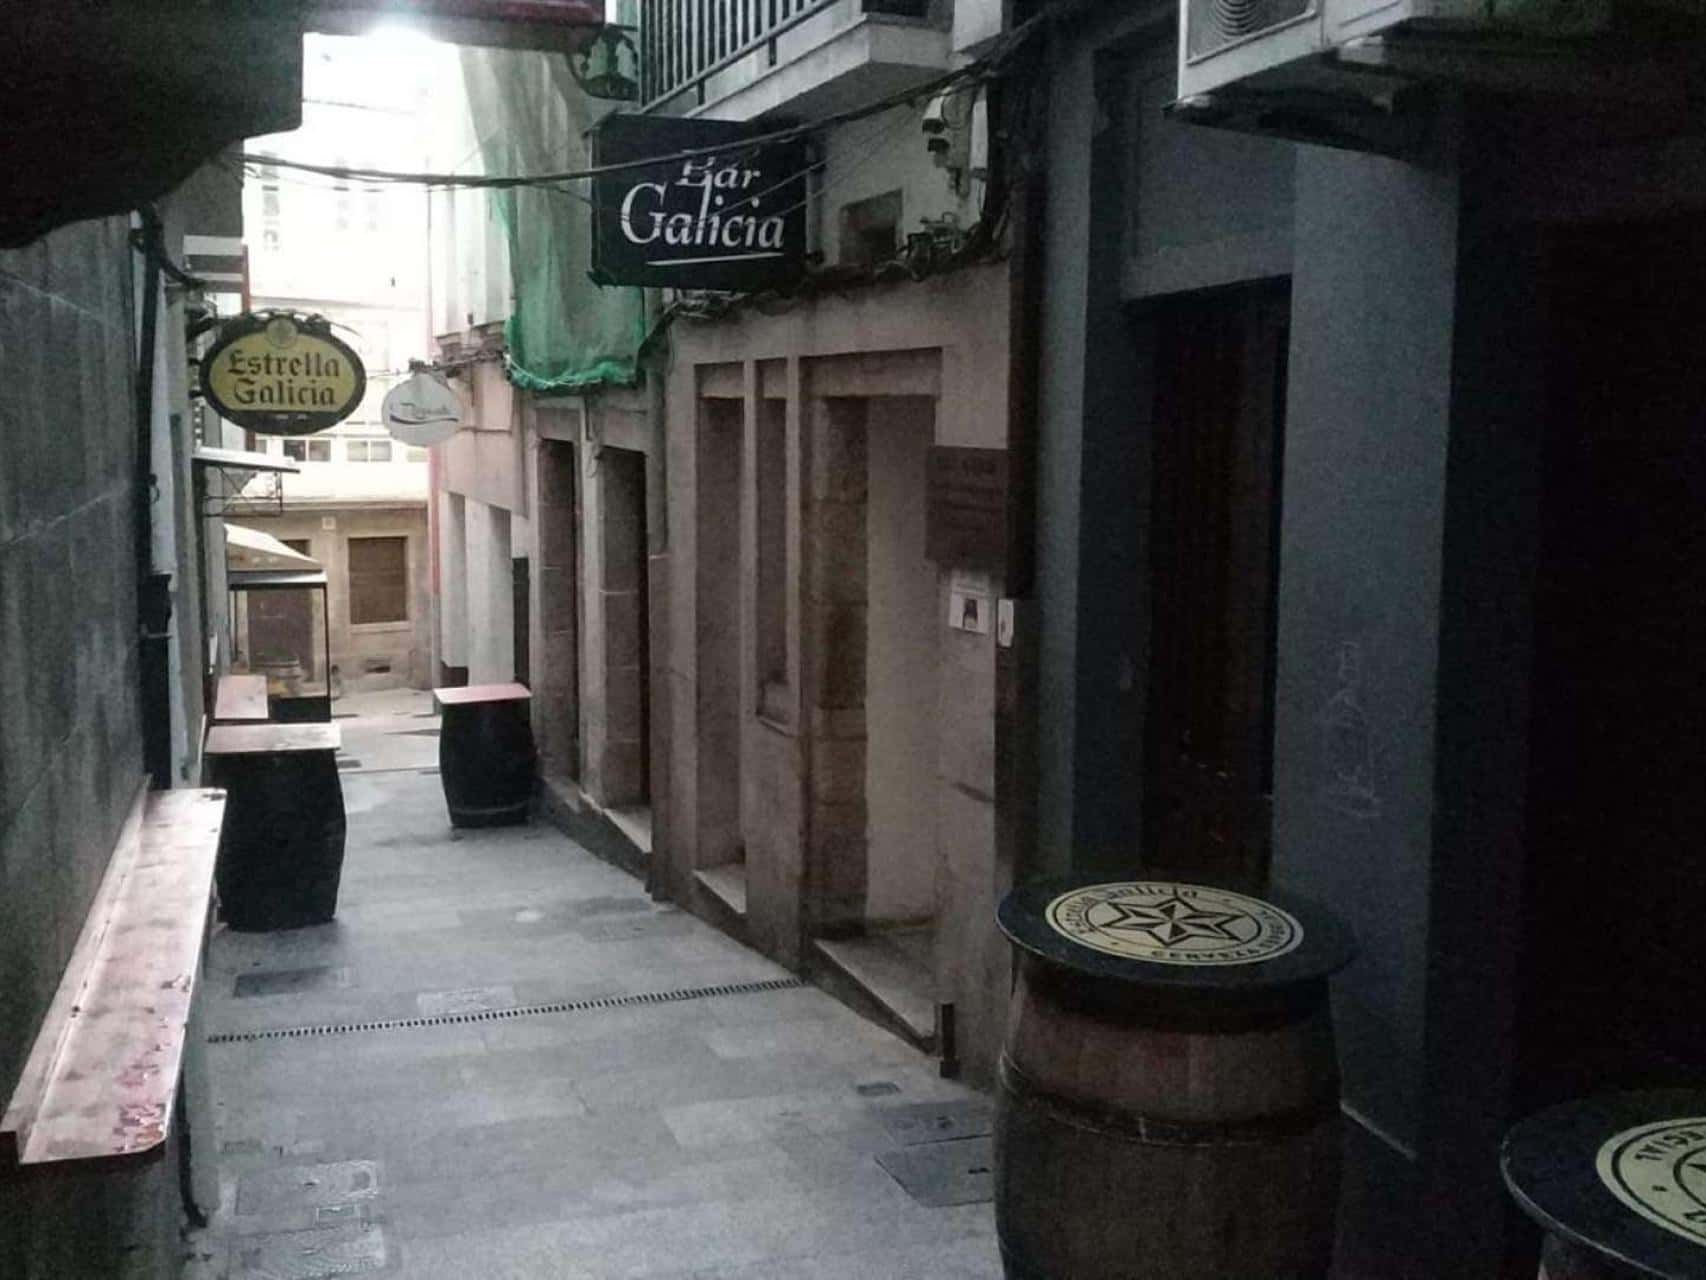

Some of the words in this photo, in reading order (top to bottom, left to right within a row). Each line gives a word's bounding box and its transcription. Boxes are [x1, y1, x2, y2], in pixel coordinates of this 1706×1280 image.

[674, 149, 761, 189] Bar
[620, 174, 785, 249] Galicia
[228, 350, 340, 377] Estrella
[234, 378, 336, 406] Galicia
